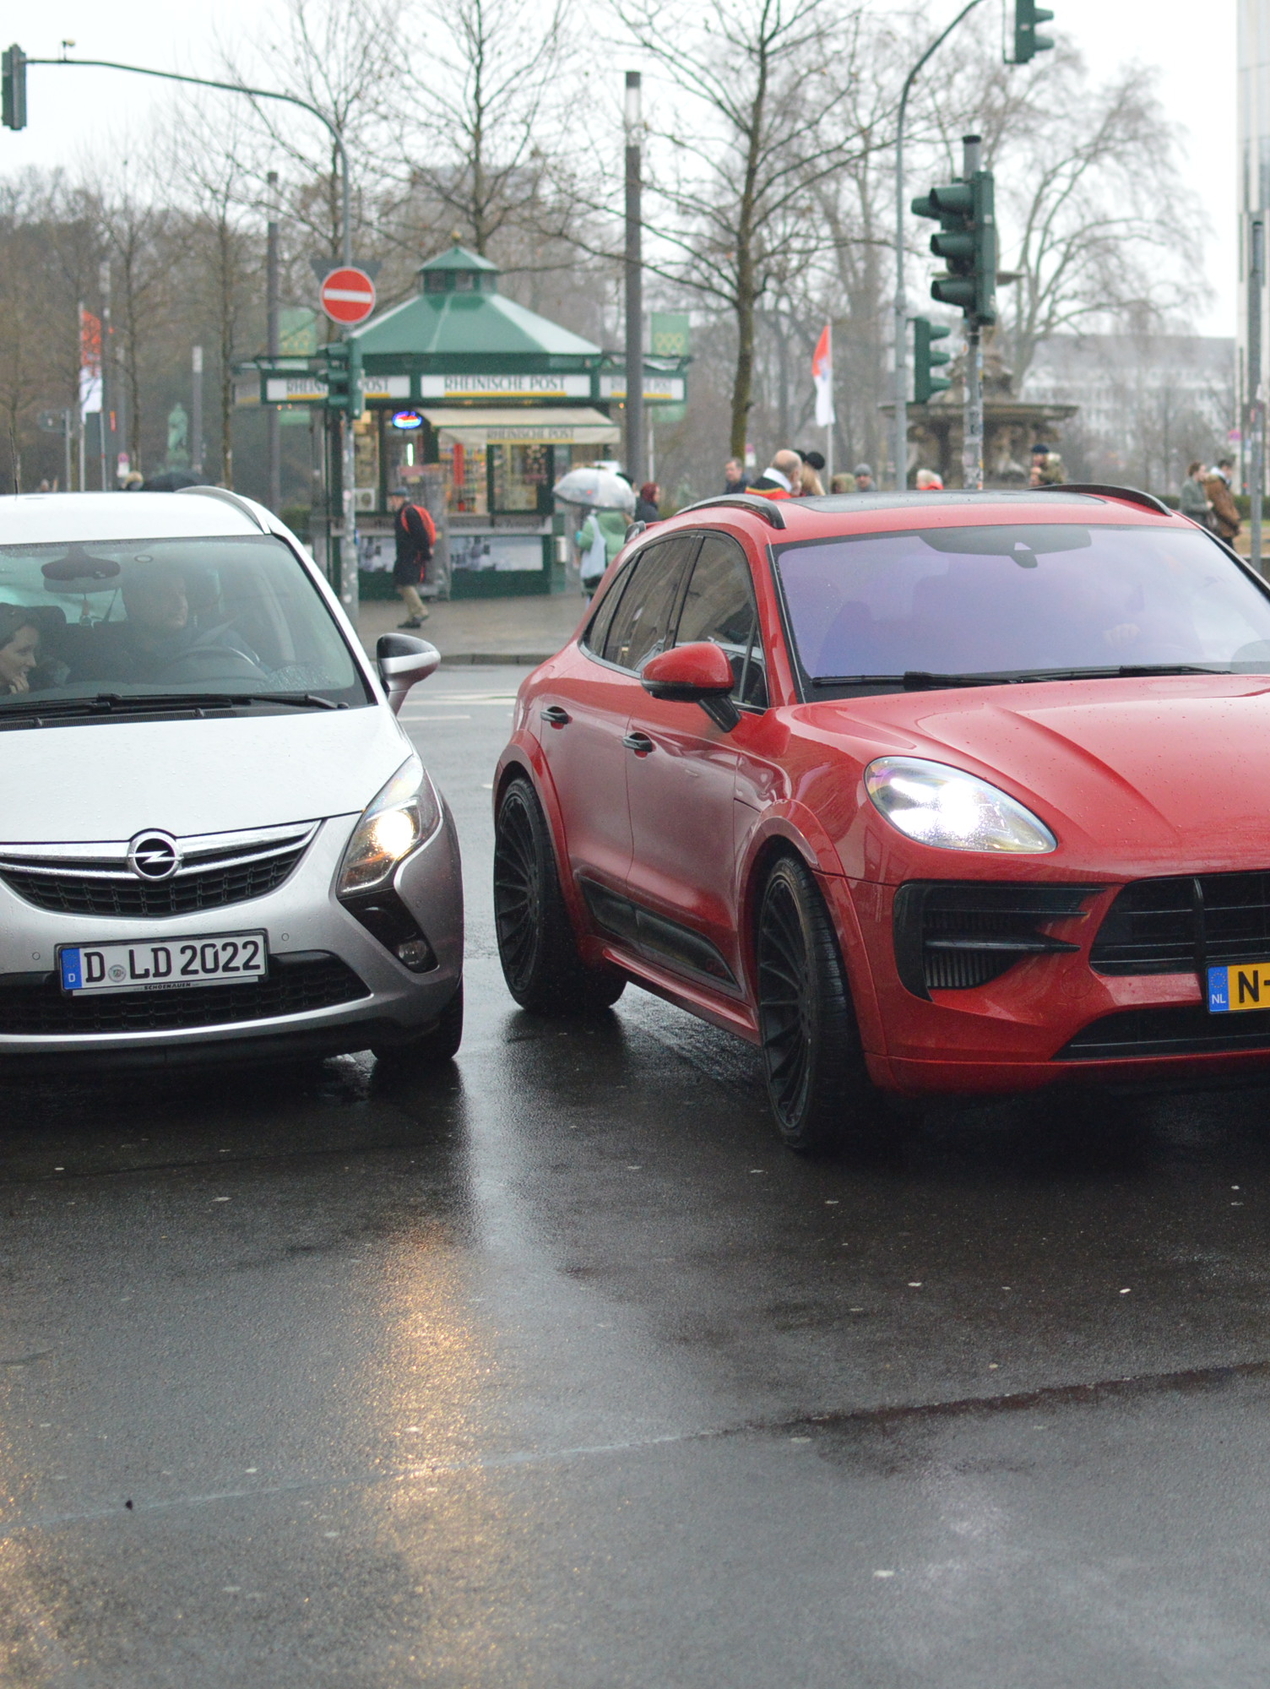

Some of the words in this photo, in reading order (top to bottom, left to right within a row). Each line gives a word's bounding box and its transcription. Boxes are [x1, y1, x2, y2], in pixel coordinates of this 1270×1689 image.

[444, 375, 525, 390] RHEINISCHE
[530, 375, 566, 390] POST
[487, 428, 544, 440] RHEINISCHE
[549, 428, 575, 440] POST
[84, 952, 105, 983] D
[129, 947, 172, 979] LD
[180, 940, 261, 976] 2022
[68, 973, 76, 983] D
[1211, 994, 1226, 1005] NL
